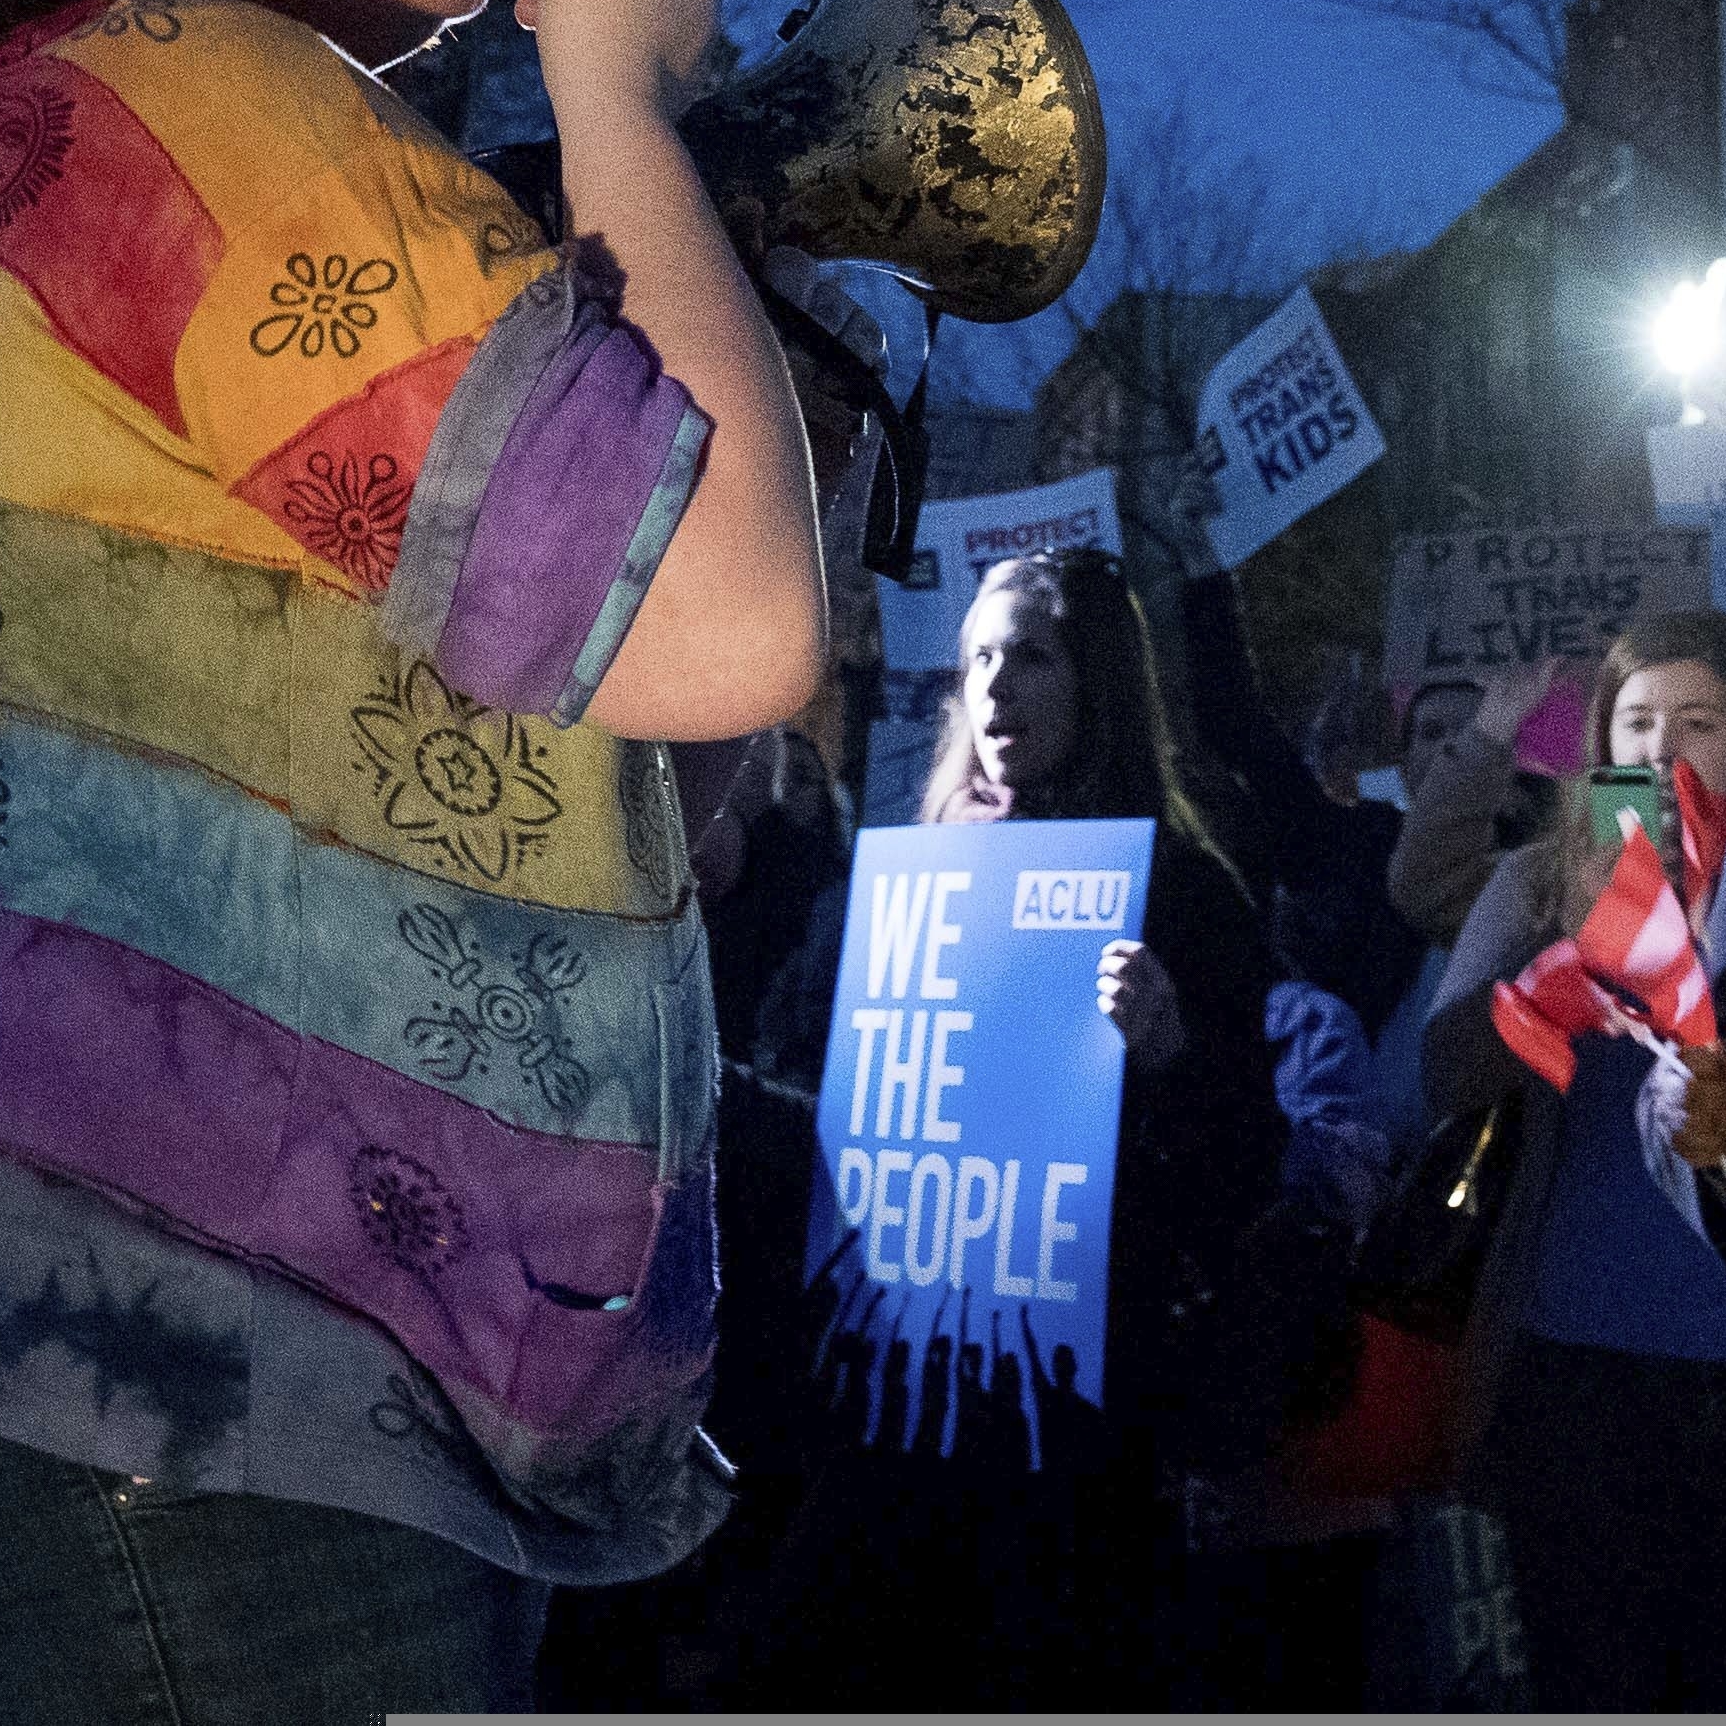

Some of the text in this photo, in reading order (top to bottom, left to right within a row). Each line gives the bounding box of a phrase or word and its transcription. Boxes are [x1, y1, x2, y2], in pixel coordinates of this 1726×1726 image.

[1231, 325, 1319, 412] PROTECT
[1238, 355, 1336, 447] TRANS
[1255, 391, 1358, 495] KIDS
[965, 508, 1099, 553] PROTECT
[1422, 529, 1709, 571] PROTECT
[1491, 574, 1641, 612] TRANS
[866, 872, 973, 1001] WE
[1021, 877, 1124, 923] ACLU
[847, 1008, 975, 1143] THE
[836, 1149, 1087, 1302] PEOPLE
